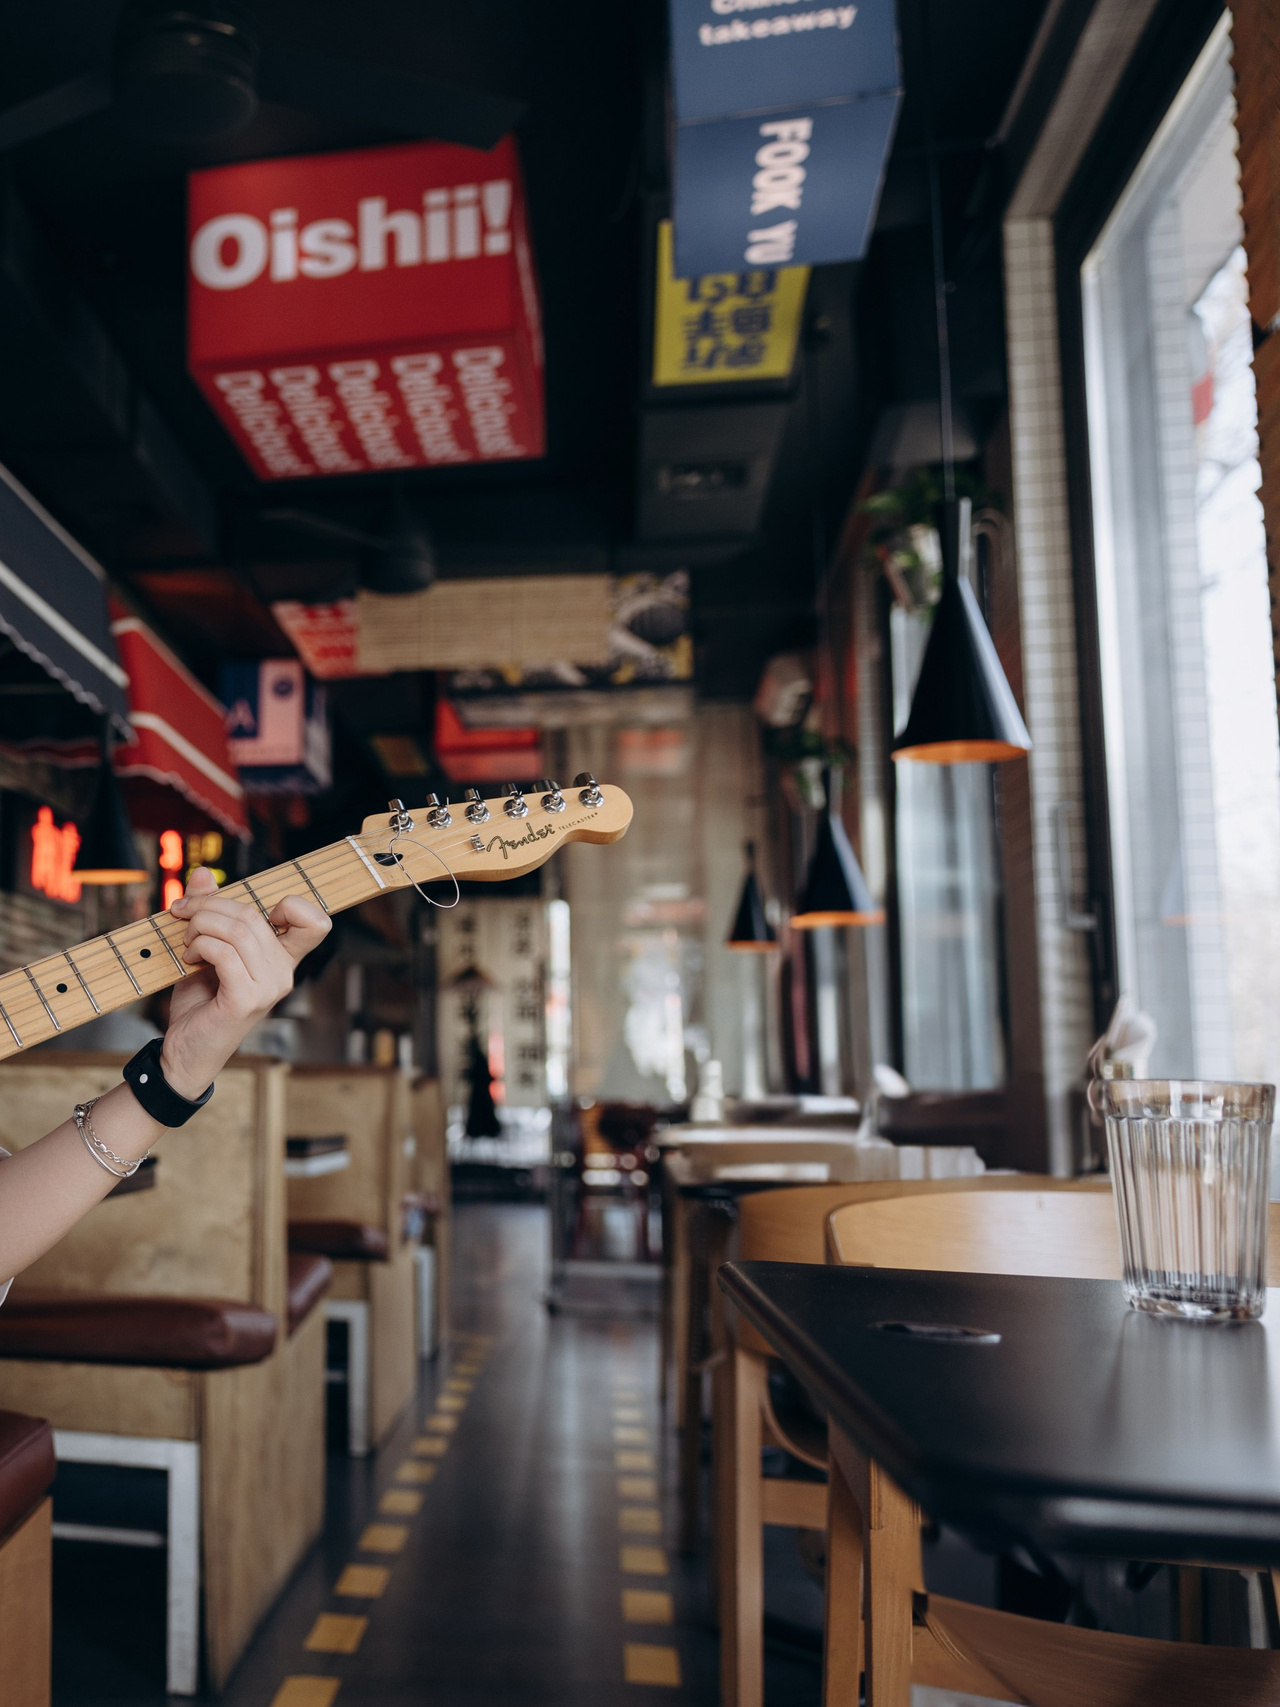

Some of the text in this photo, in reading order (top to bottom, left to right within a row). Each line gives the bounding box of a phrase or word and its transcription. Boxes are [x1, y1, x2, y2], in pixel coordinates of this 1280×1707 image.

[699, 5, 858, 46] takeaway
[744, 117, 813, 265] FOOK YU
[190, 179, 512, 290] Oishii!
[486, 822, 555, 860] Fender
